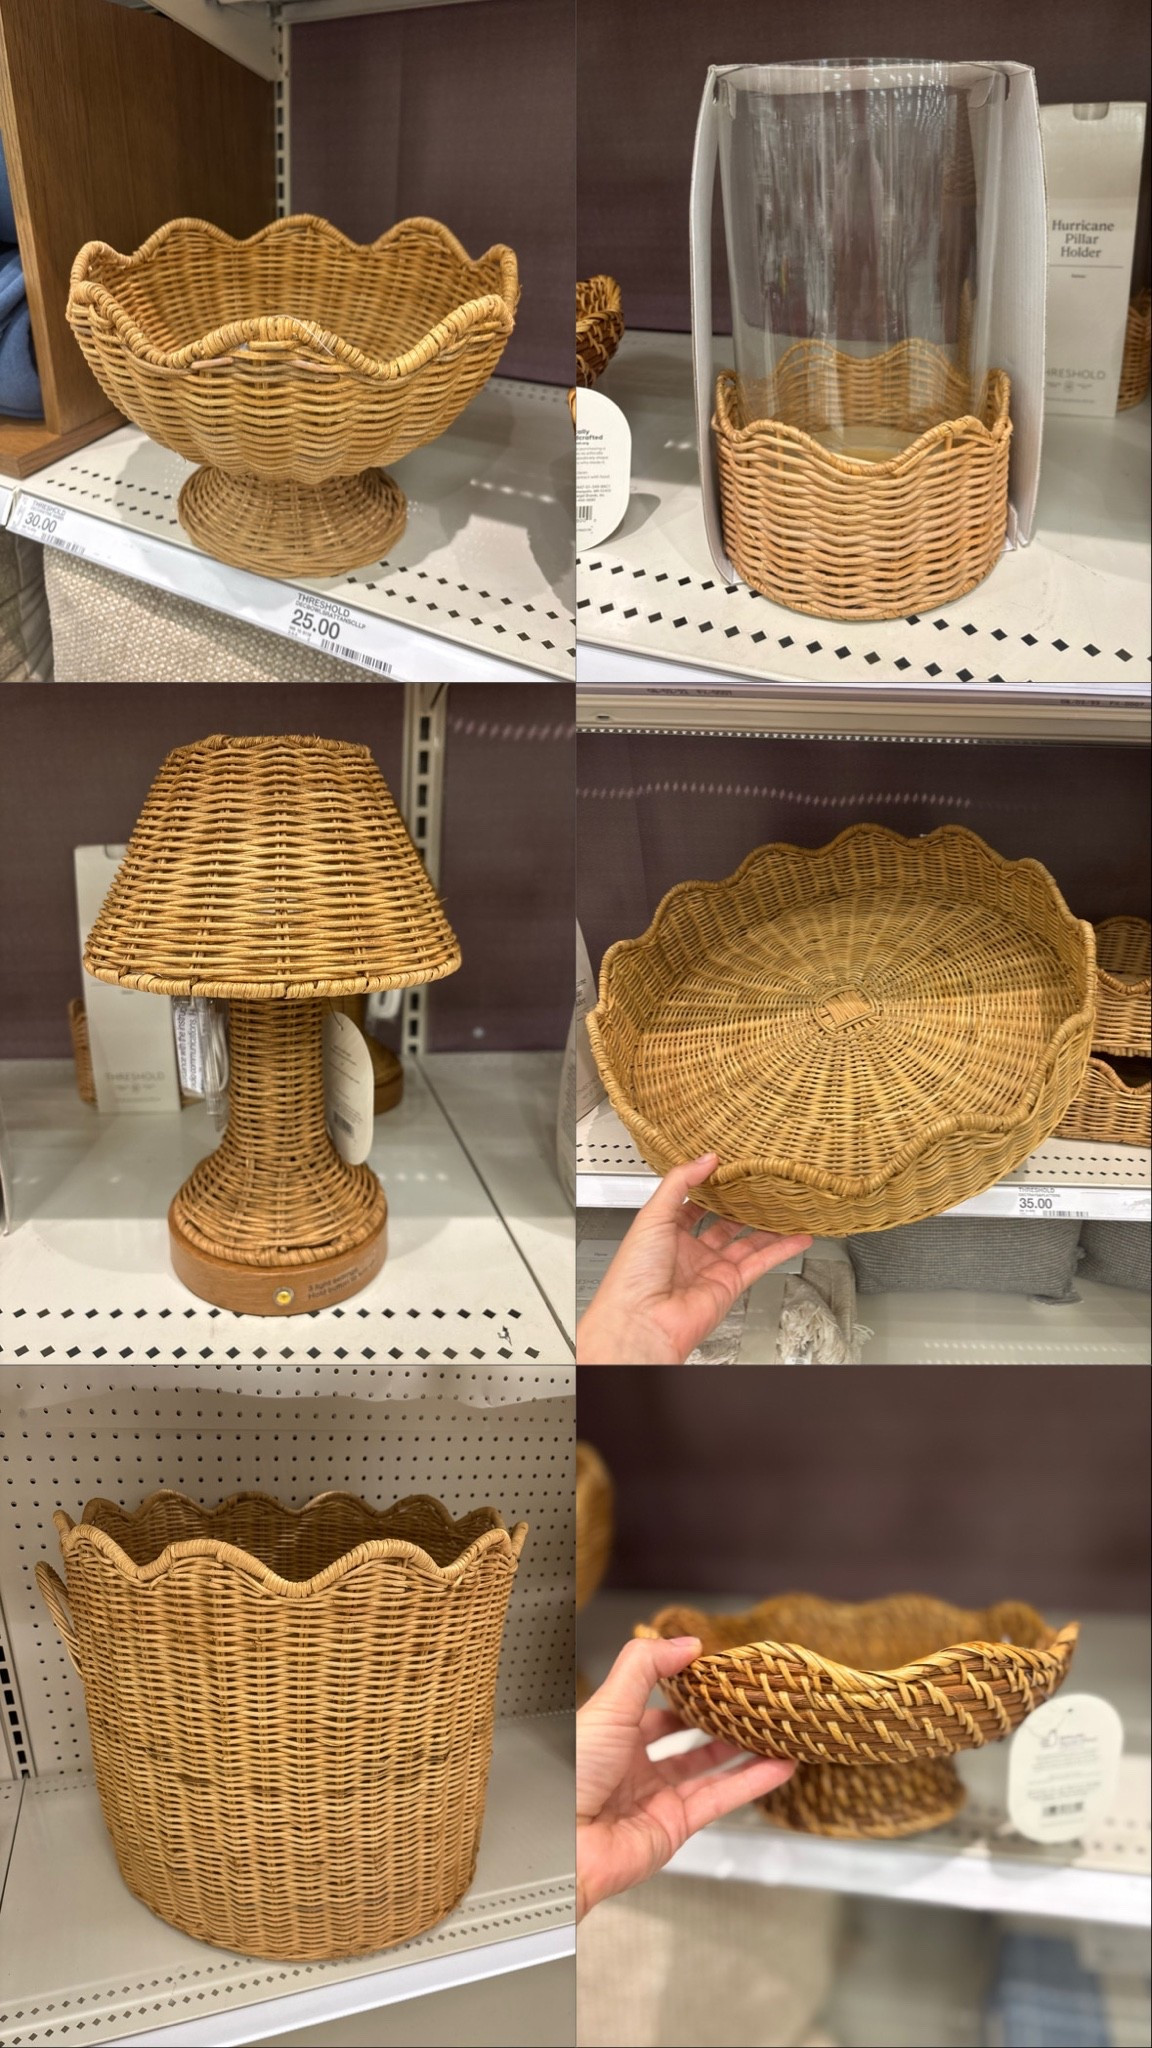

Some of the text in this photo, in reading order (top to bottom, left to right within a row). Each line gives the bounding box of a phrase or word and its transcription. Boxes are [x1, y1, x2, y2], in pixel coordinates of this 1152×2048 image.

[1051, 219, 1115, 232] Hurricane
[1064, 233, 1100, 245] Pillar
[1060, 246, 1103, 259] Holder
[25, 512, 57, 533] 30.00
[297, 592, 350, 618] THRESHOLD
[291, 609, 341, 640] 25.00
[1019, 1197, 1053, 1209] 35.00
